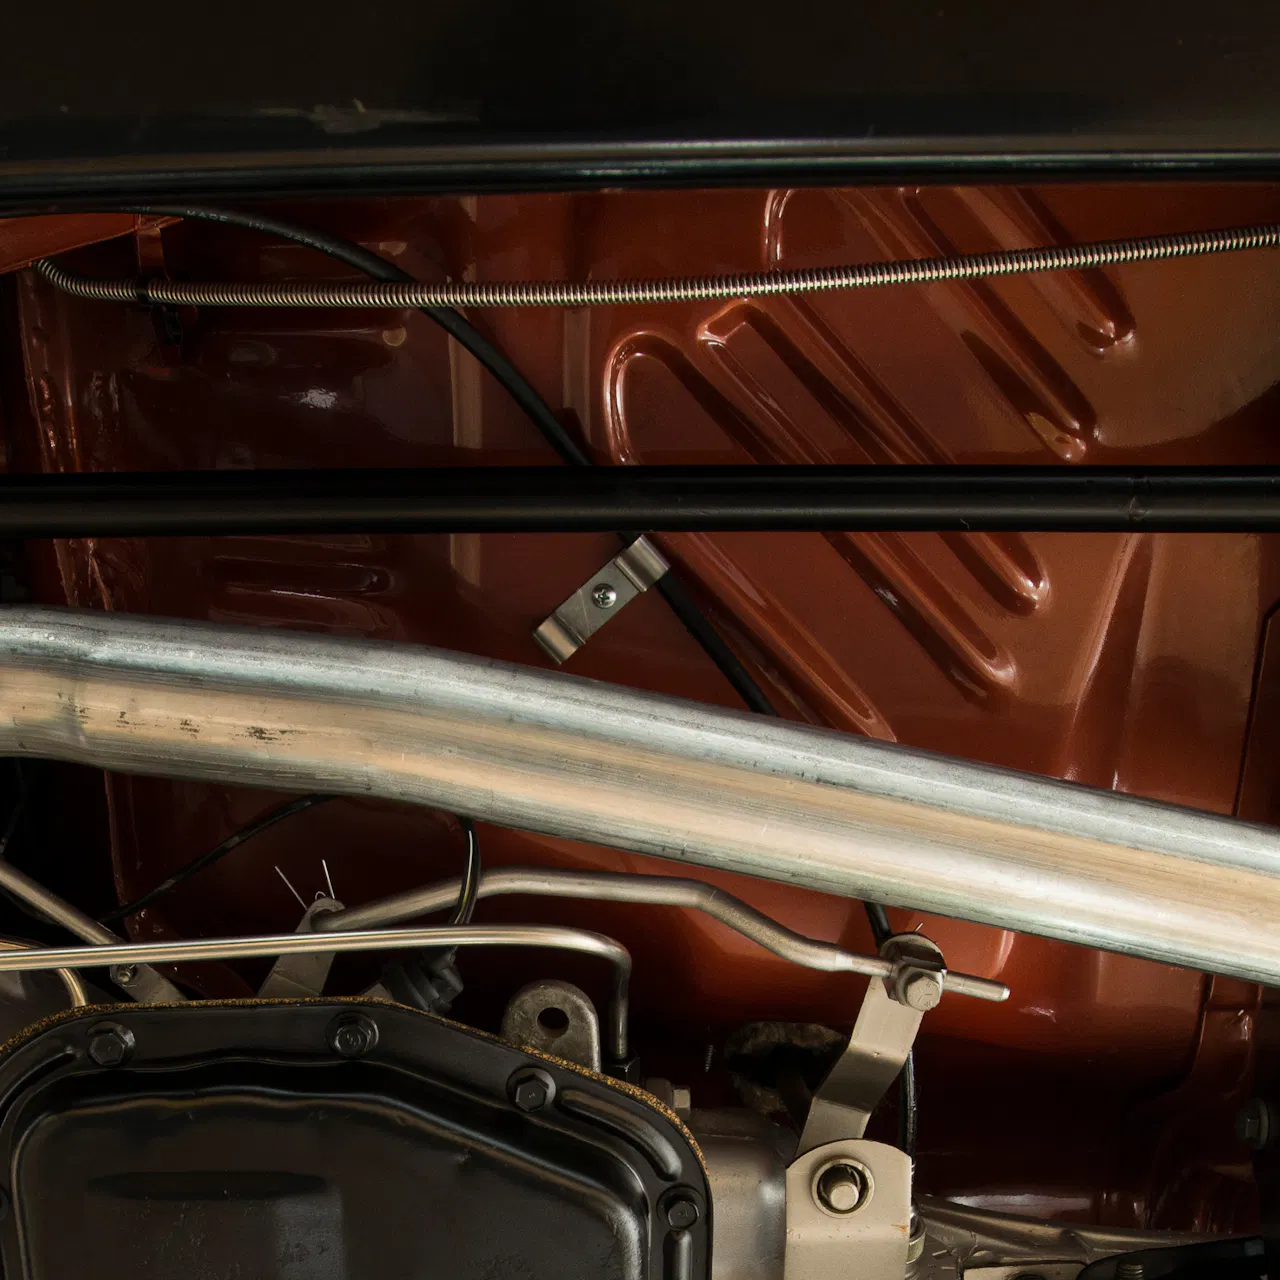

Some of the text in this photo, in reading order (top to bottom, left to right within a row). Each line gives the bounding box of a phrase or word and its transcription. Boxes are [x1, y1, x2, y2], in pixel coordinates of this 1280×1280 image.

[186, 208, 332, 253] MADE IN JAPAN
